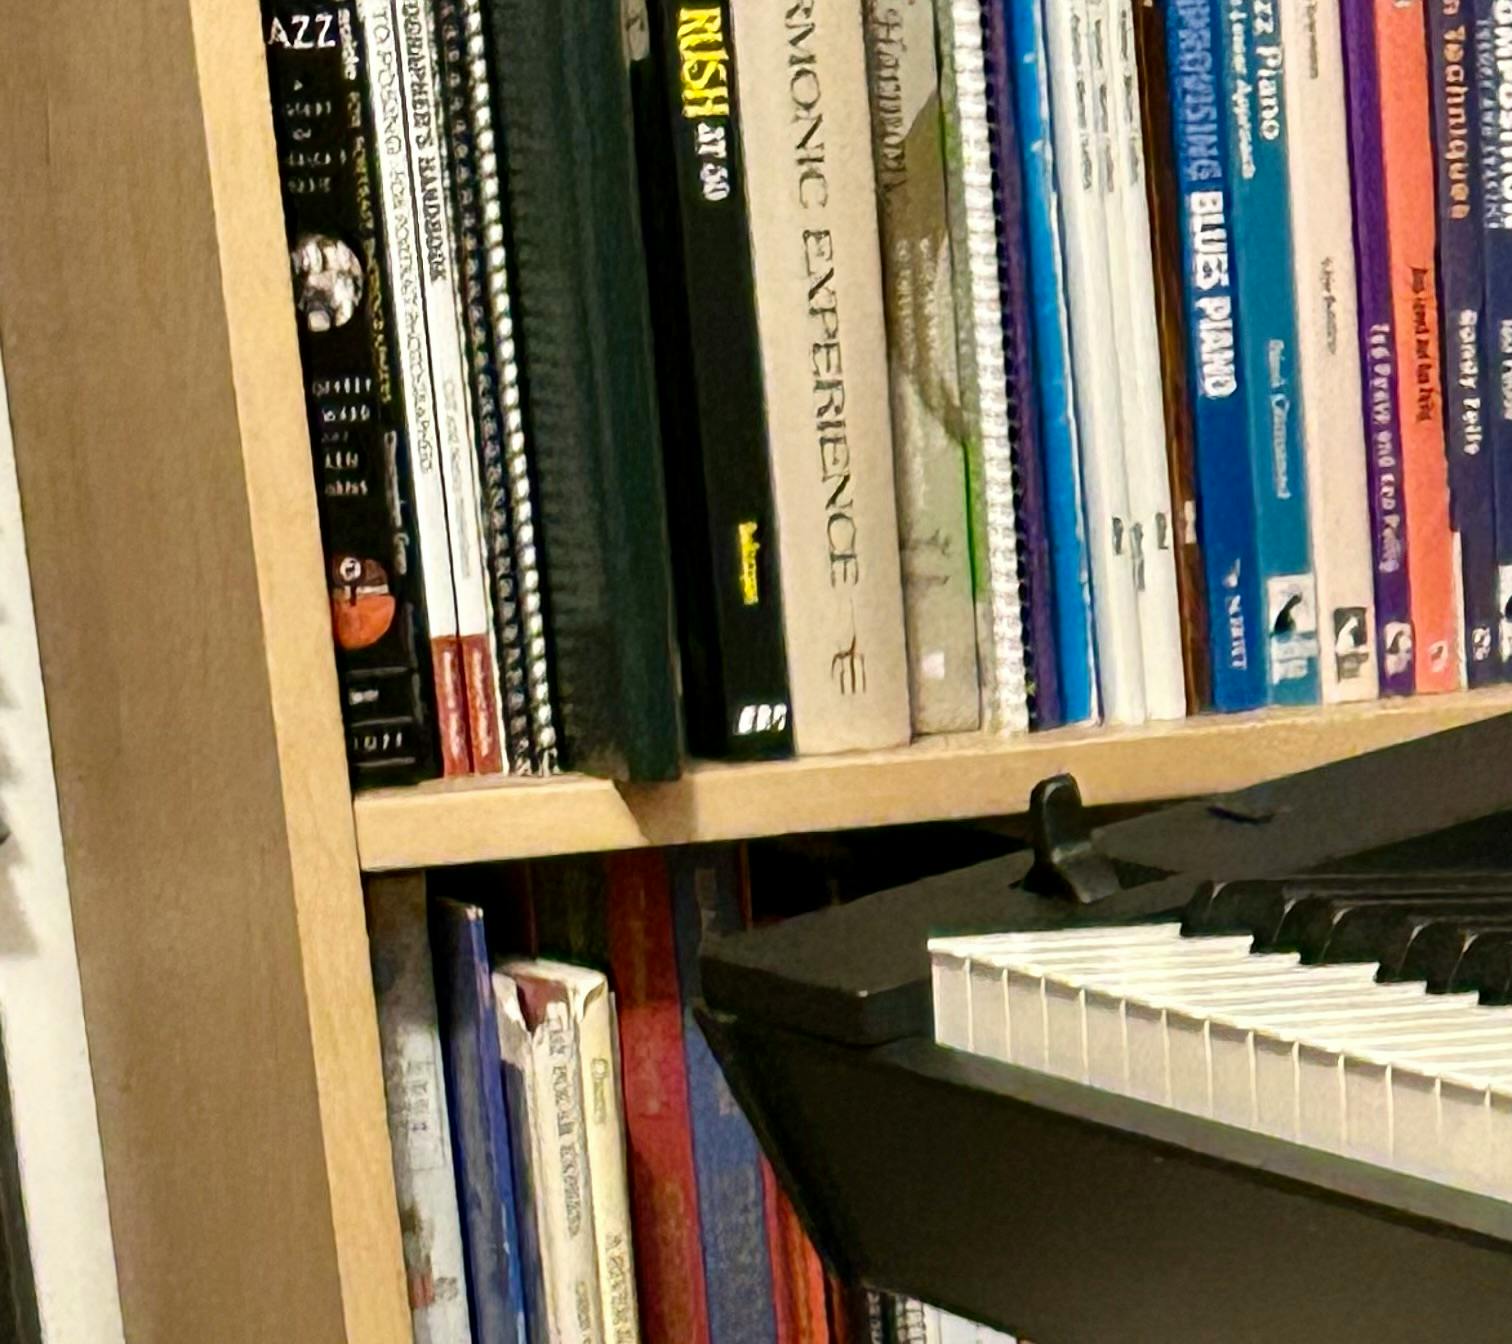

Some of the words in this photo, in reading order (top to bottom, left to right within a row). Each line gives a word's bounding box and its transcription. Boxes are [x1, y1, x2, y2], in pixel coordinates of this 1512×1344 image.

[677, 8, 730, 119] RUSH
[1256, 44, 1284, 140] Piano
[1443, 25, 1471, 219] Techniques
[1190, 191, 1230, 291] BLUES
[1195, 296, 1238, 399] PIANO
[801, 228, 860, 590] EXPERIENCE
